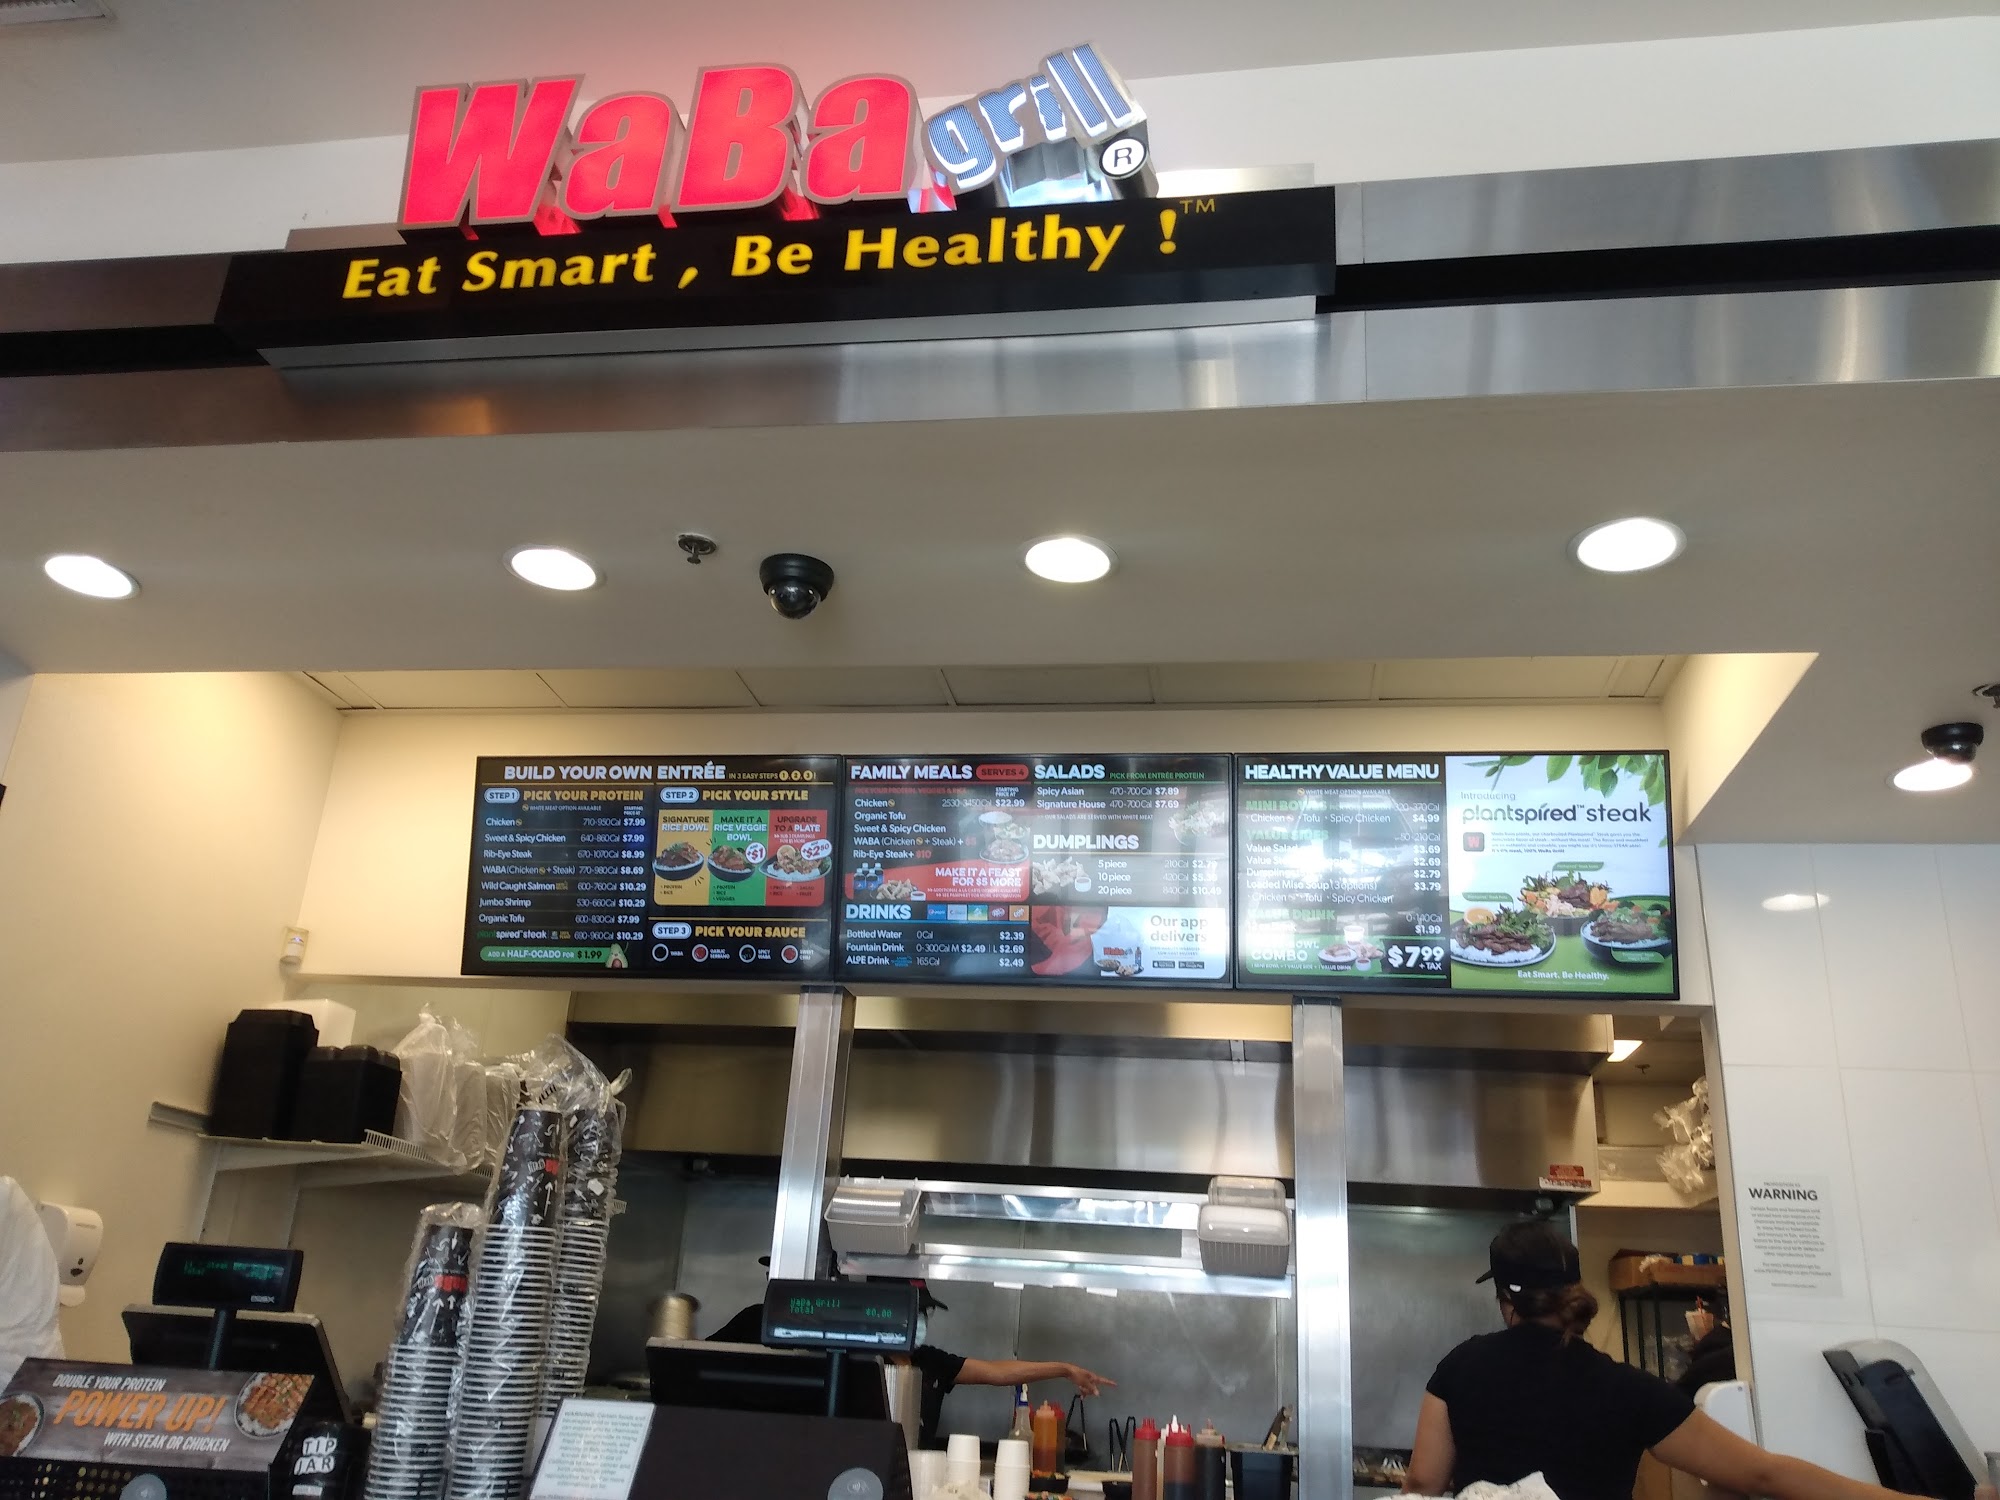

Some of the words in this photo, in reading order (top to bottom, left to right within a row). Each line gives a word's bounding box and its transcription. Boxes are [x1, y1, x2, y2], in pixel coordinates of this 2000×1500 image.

[399, 64, 918, 229] WaBa
[925, 42, 1134, 190] grill
[342, 257, 441, 299] Eat
[461, 244, 656, 292] Smart
[731, 235, 813, 276] Be
[844, 214, 1125, 271] Healthy
[504, 766, 555, 780] BUILD
[559, 766, 607, 780] YOUR
[609, 766, 652, 780] OWN
[657, 761, 726, 780] ENTRÉE
[850, 764, 910, 780] FAMILY
[913, 764, 972, 780] MEALS
[980, 766, 1017, 777] SERVES
[1018, 767, 1025, 777] 4
[1034, 764, 1106, 779] SALADS
[1245, 764, 1325, 779] HEALTHY
[1325, 764, 1384, 779] VALUE
[1386, 763, 1439, 779] MENU
[1174, 772, 1205, 780] PROTEIN
[523, 790, 551, 801] PICK
[554, 790, 588, 801] YOUR
[589, 790, 644, 801] PROTEIN
[702, 789, 733, 801] PICK
[734, 789, 770, 801] YOUR
[770, 789, 808, 801] STYLE
[1037, 787, 1060, 797] Spicy
[1060, 787, 1084, 796] Asian
[1155, 787, 1179, 796] $7.89
[1460, 791, 1516, 801] Introducing
[854, 798, 888, 808] Chicken
[995, 799, 1025, 808] $22.99
[1036, 800, 1077, 810] Signature
[1078, 800, 1106, 809] House
[1155, 800, 1179, 809] $7.69
[854, 812, 887, 822] Organic
[888, 812, 906, 820] Tofu
[1586, 802, 1652, 822] steak
[485, 817, 515, 826] Chicken
[623, 818, 646, 826] $7.99
[1250, 814, 1285, 823] Chicken
[1303, 814, 1321, 823] Tofu
[1329, 814, 1354, 824] Spicy
[1355, 814, 1391, 823] Chicken
[1412, 814, 1440, 823] $4.99
[661, 824, 682, 832] RICE
[682, 824, 709, 832] BOWL
[714, 824, 734, 832] RICE
[735, 824, 767, 832] VEGGIE
[854, 825, 880, 833] Sweet
[880, 825, 888, 833] &
[889, 825, 912, 835] Spicy
[912, 824, 946, 833] Chicken
[485, 834, 508, 842] Sweet
[508, 834, 515, 842] &
[515, 834, 535, 844] Spicy
[535, 833, 566, 842] Chicken
[622, 834, 645, 843] $7.99
[726, 834, 753, 842] BOWL
[1247, 830, 1289, 841] VALUE
[1033, 834, 1139, 850] DUMPLINGS
[1246, 844, 1271, 853] Value
[1272, 844, 1299, 853] Salad
[1413, 845, 1440, 854] $3.69
[483, 850, 511, 860] Rib-Eye
[512, 850, 532, 859] Steak
[621, 850, 645, 859] $8.99
[1097, 860, 1104, 868] 5
[1104, 860, 1127, 869] piece
[1246, 856, 1271, 865] Value
[1413, 857, 1441, 867] $2.69
[620, 866, 644, 875] $8.69
[935, 868, 966, 877] MAKE
[966, 868, 976, 877] IT
[977, 868, 986, 877] A
[987, 868, 1022, 878] FEAST
[1413, 869, 1441, 879] $2.79
[952, 878, 973, 887] FOR
[975, 878, 988, 887] $5
[989, 878, 1022, 887] MORE
[1098, 873, 1108, 881] 10
[1108, 873, 1131, 882] piece
[481, 881, 499, 891] Wild
[499, 882, 527, 892] Caught
[527, 882, 555, 891] Salmon
[619, 882, 647, 892] $10.29
[1097, 886, 1109, 895] 20
[1109, 886, 1132, 896] piece
[1191, 886, 1222, 895] $10.49
[1413, 882, 1441, 891] $3.79
[479, 898, 504, 908] Jumbo
[504, 898, 532, 909] Shrimp
[618, 899, 646, 908] $10.29
[1252, 893, 1287, 902] Chicken
[1304, 893, 1323, 902] Tofu
[1331, 893, 1356, 904] Spicy
[1357, 893, 1393, 903] Chicken
[846, 904, 911, 920] DRINKS
[478, 914, 508, 924] Organic
[509, 914, 525, 923] Tofu
[617, 915, 640, 924] $7.99
[1150, 915, 1178, 927] Our
[1180, 916, 1209, 930] app
[695, 926, 724, 937] PICK
[726, 926, 763, 938] YOUR
[764, 927, 806, 938] SAUCE
[847, 929, 876, 939] Bottled
[877, 930, 903, 939] Water
[1415, 924, 1441, 934] $1.99
[616, 931, 644, 941] $10.29
[999, 931, 1024, 940] $2.39
[1150, 930, 1208, 942] delivers
[846, 943, 881, 952] Fountain
[881, 943, 904, 952] Drink
[867, 956, 890, 965] Drink
[1251, 950, 1308, 961] COMBO
[999, 958, 1024, 967] $2.49
[1517, 969, 1532, 979] Eat
[1532, 970, 1560, 979] Smart.
[1561, 971, 1574, 980] Be
[1574, 971, 1610, 981] Healthy.
[1748, 1187, 1818, 1201] WARNING
[53, 1373, 96, 1388] DOUBLE
[94, 1376, 122, 1390] YOUR
[120, 1377, 167, 1391] PROTEIN
[54, 1390, 165, 1431] POWER
[163, 1393, 227, 1433] UP!
[103, 1432, 134, 1448] WITH
[131, 1434, 167, 1450] STEAK
[166, 1435, 184, 1450] OR
[182, 1437, 231, 1452] CHICKEN
[304, 1440, 335, 1453] TIP
[297, 1457, 332, 1475] JAR
